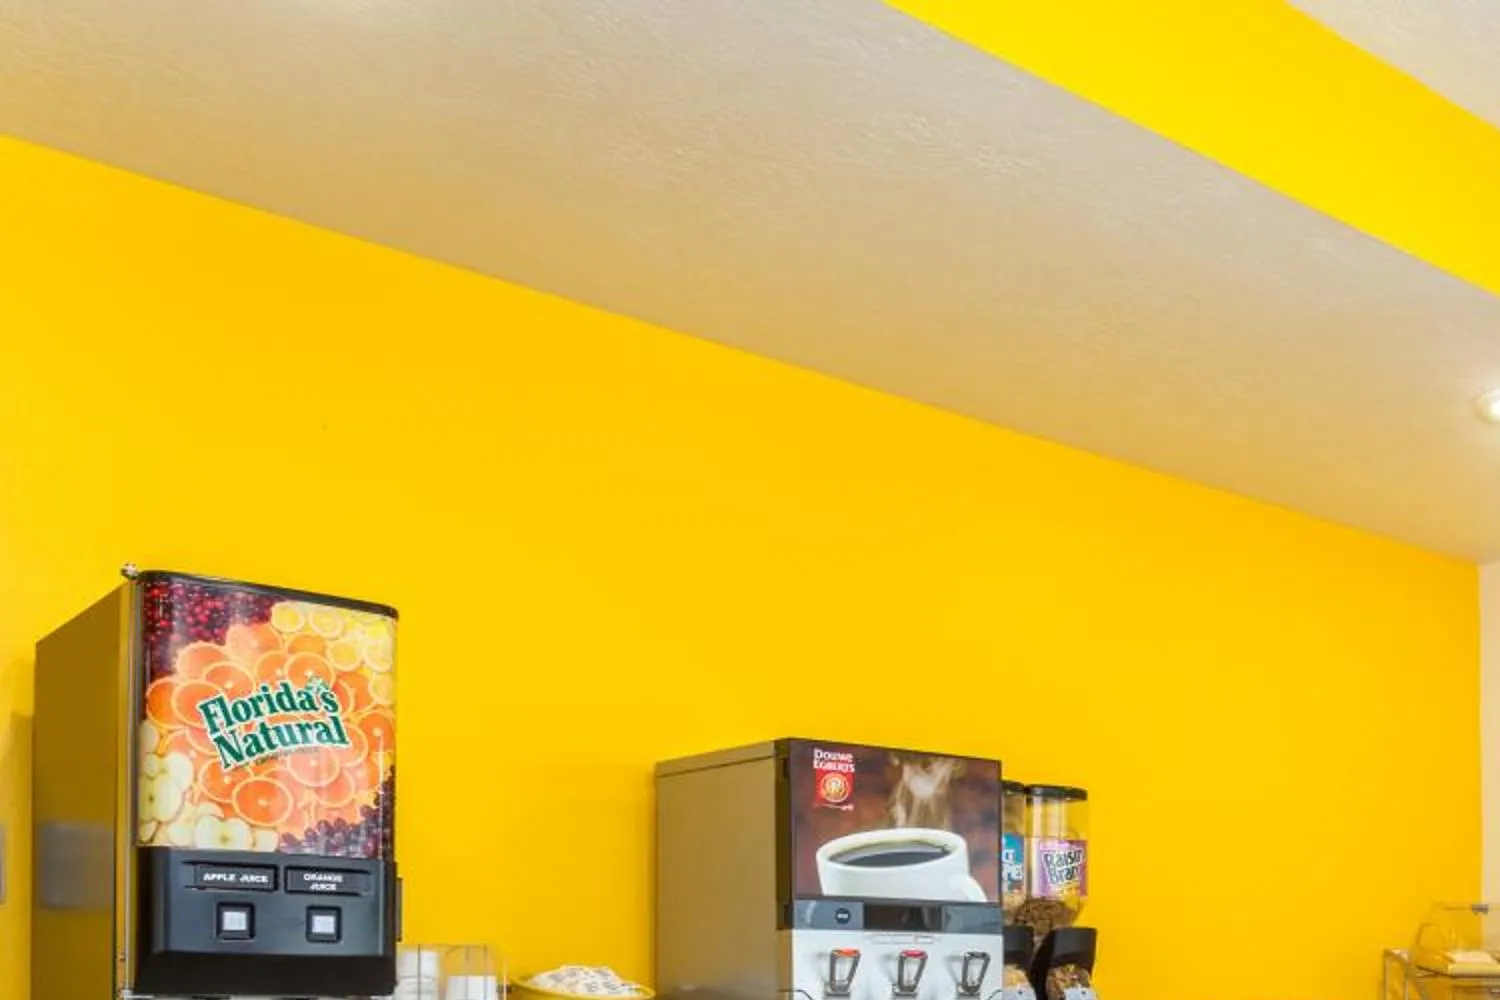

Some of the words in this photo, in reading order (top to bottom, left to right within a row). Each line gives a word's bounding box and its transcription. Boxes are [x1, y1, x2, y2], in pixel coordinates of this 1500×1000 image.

[198, 680, 340, 736] Florida's
[213, 714, 351, 770] Natural
[203, 871, 236, 882] APPLE
[239, 873, 269, 884] JUICE
[303, 872, 344, 883] ORANGE
[310, 883, 337, 891] JUICE
